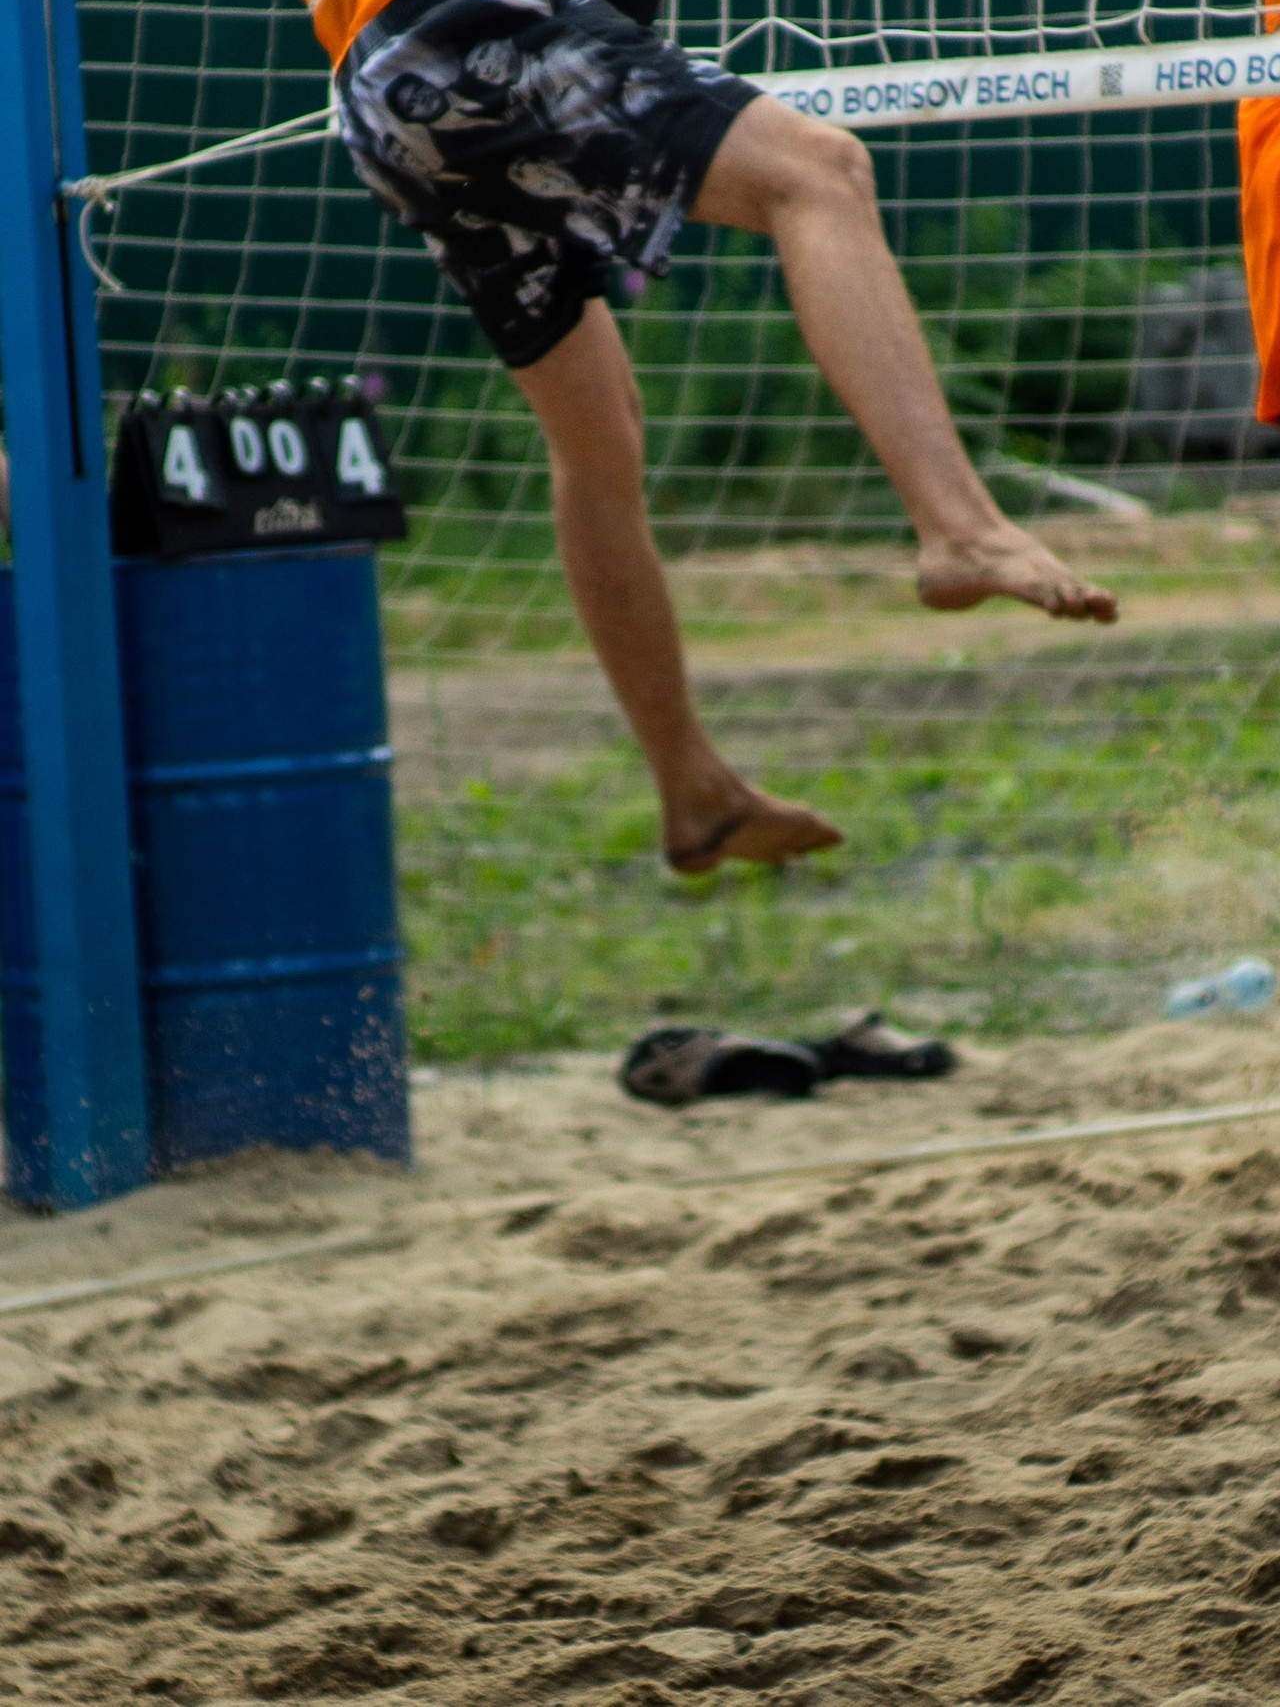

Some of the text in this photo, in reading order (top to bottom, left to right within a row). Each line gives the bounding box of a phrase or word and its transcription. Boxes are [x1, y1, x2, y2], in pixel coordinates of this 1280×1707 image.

[842, 77, 968, 114] BORISOV
[975, 69, 1071, 105] BEACH
[1154, 57, 1237, 93] HERO
[162, 424, 207, 501] 4
[336, 415, 386, 496] 4
